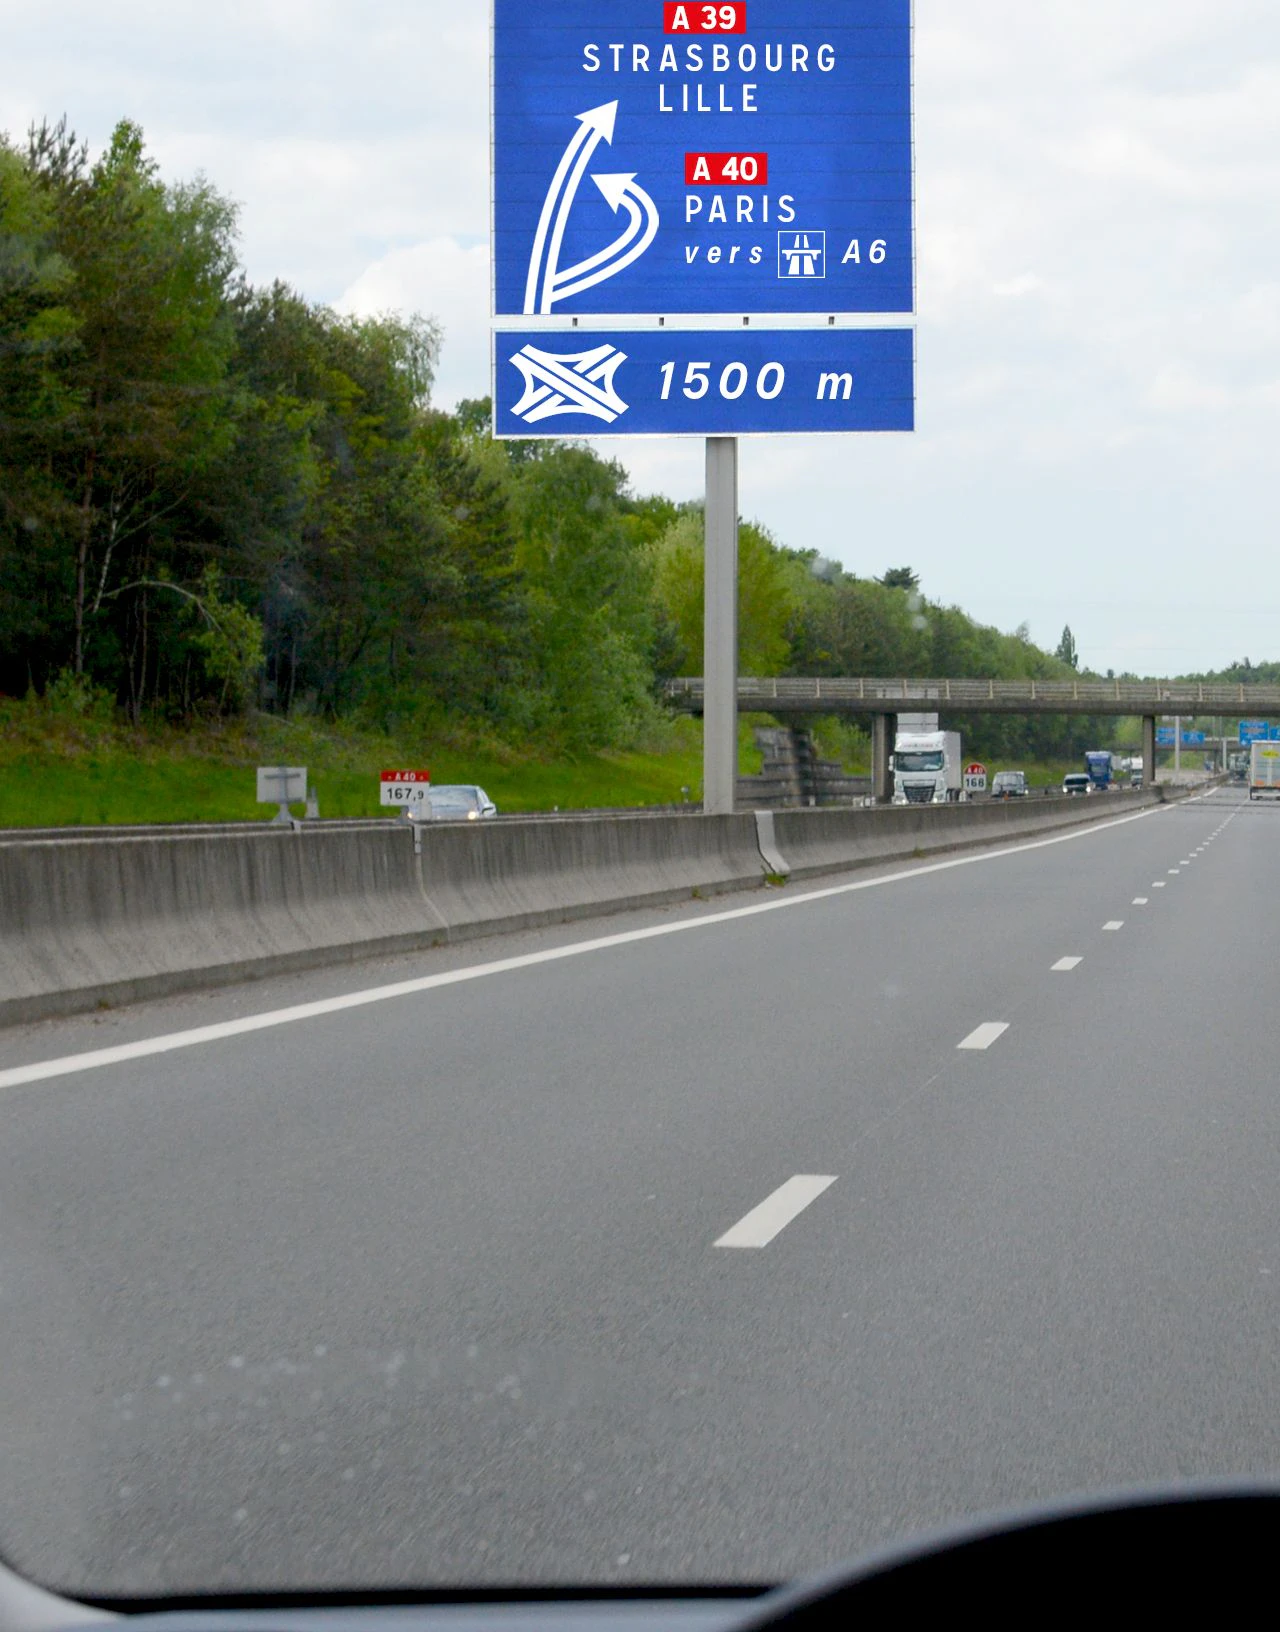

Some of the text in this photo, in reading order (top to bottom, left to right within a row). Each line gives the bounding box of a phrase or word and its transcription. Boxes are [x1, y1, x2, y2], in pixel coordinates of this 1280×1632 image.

[672, 6, 735, 29] A 39
[583, 44, 834, 71] STRASBOURG
[660, 84, 757, 111] LILLE
[693, 157, 757, 180] A 40
[686, 195, 795, 222] PARIS
[686, 240, 886, 263] vers A6
[661, 362, 852, 399] 1500 m
[402, 771, 416, 781] 40
[966, 778, 985, 788] 168
[387, 787, 424, 802] 167,9
